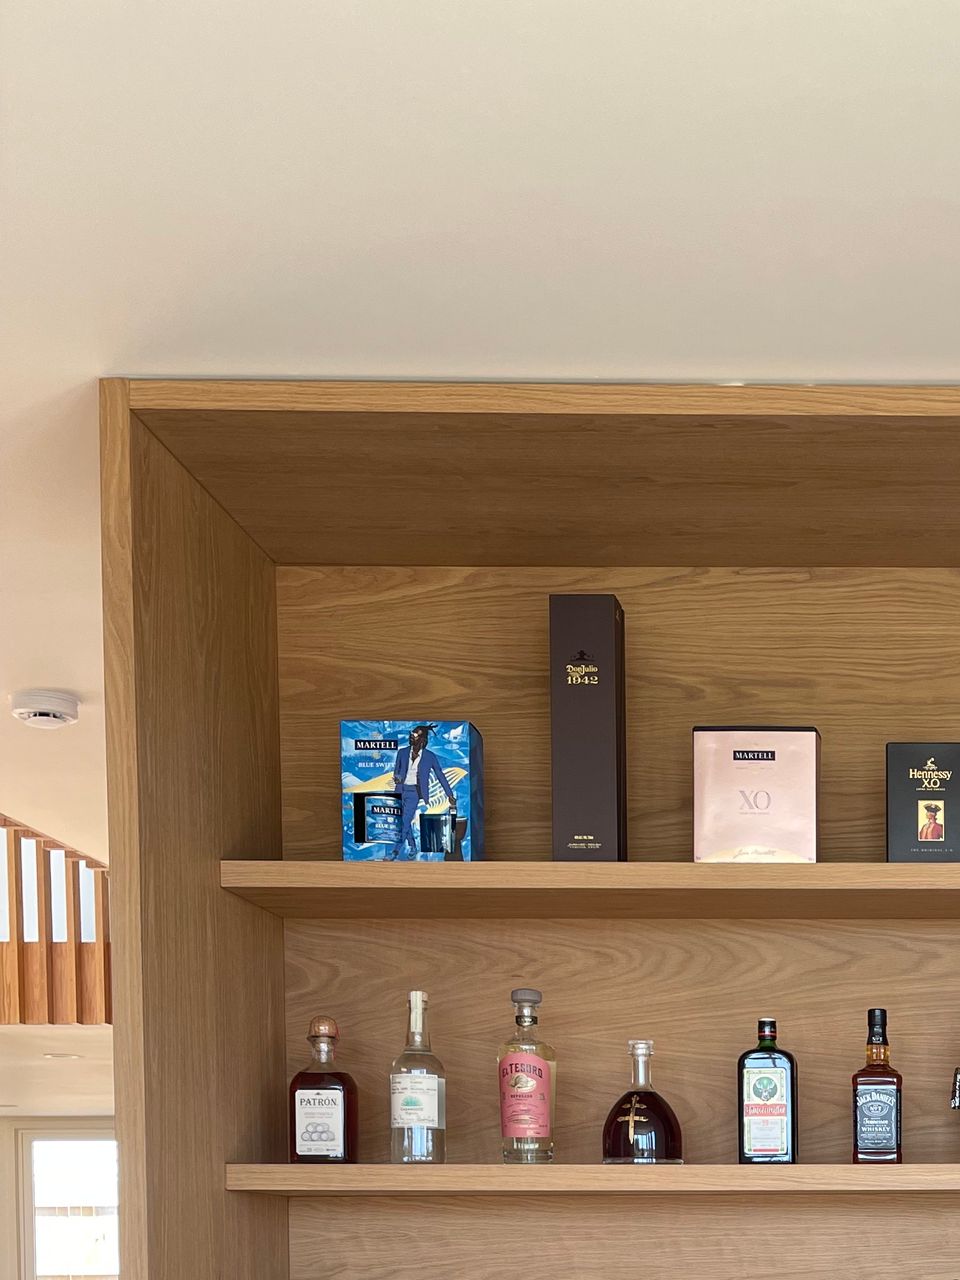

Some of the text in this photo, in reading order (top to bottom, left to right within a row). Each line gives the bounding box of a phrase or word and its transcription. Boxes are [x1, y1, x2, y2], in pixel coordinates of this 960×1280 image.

[566, 676, 599, 685] 1942
[356, 741, 397, 749] MARTELL
[908, 768, 953, 780] Hennessy
[739, 790, 771, 810] XO
[508, 1062, 544, 1079] TESORO
[300, 1096, 337, 1106] PATRÓN
[856, 1093, 872, 1107] JACK
